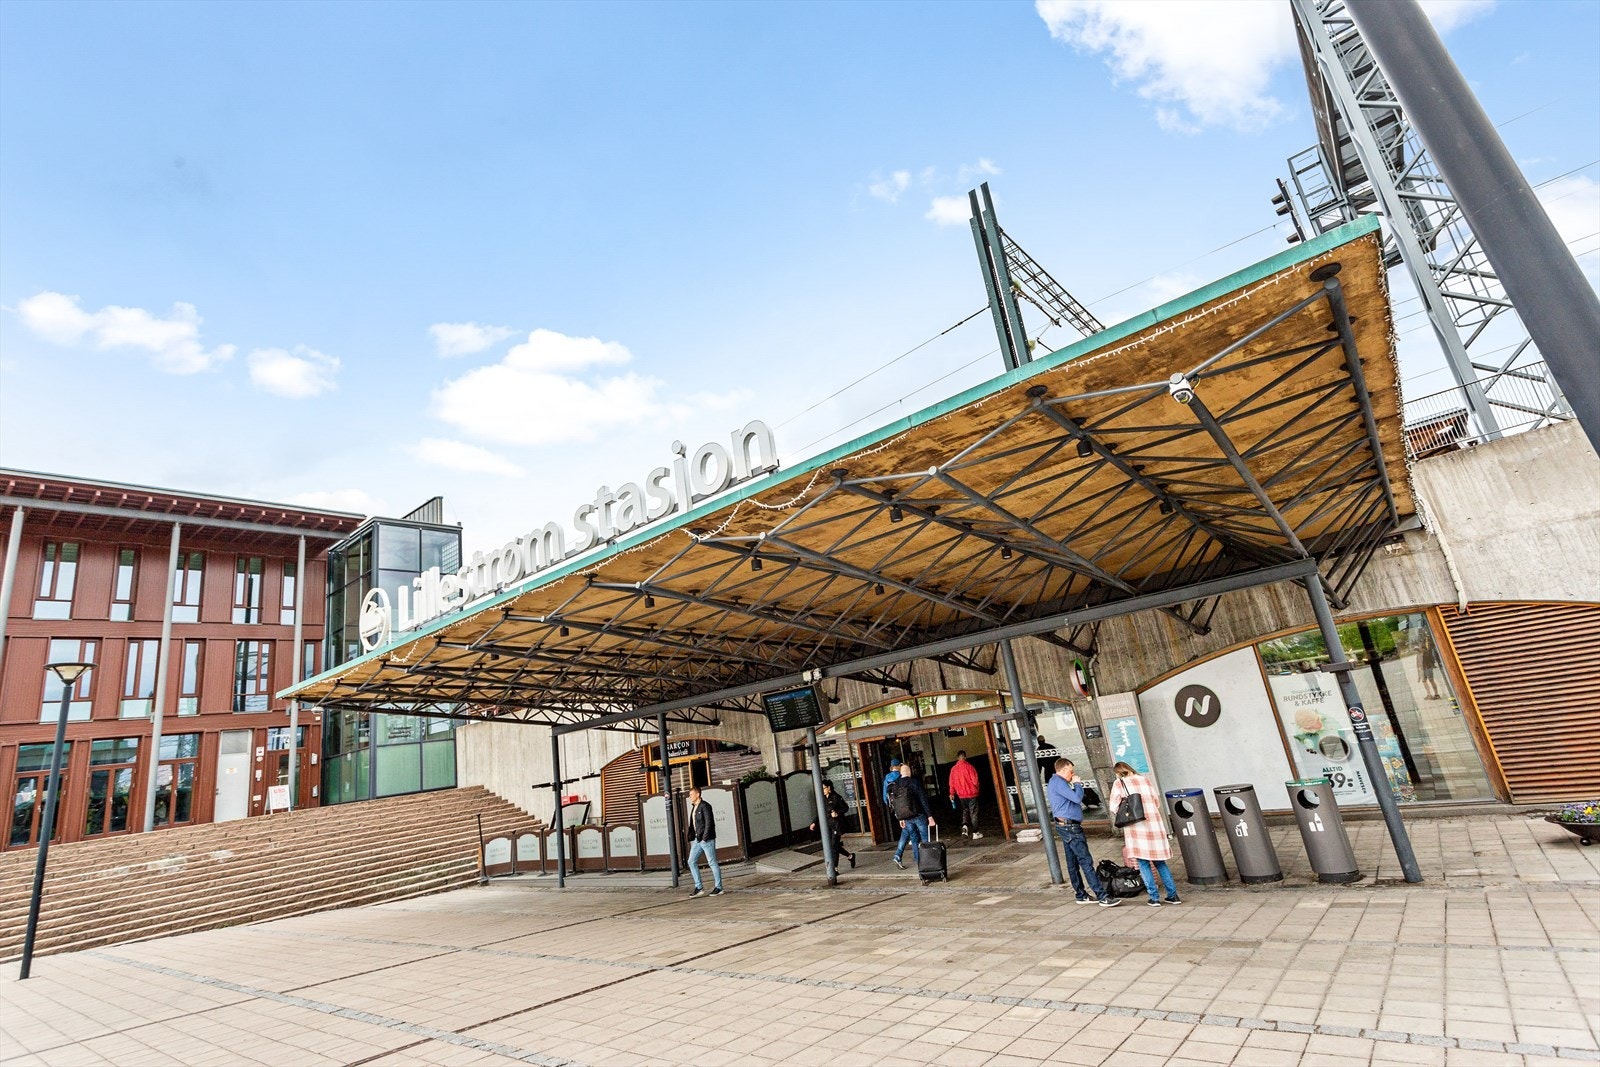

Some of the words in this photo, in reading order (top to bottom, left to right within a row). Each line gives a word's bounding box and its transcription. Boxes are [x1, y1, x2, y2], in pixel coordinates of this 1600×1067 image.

[397, 521, 566, 631] Lillestrøm
[574, 419, 779, 551] stasjon
[1283, 690, 1333, 702] RUNDSTYKKE
[1302, 697, 1325, 706] KAFFE
